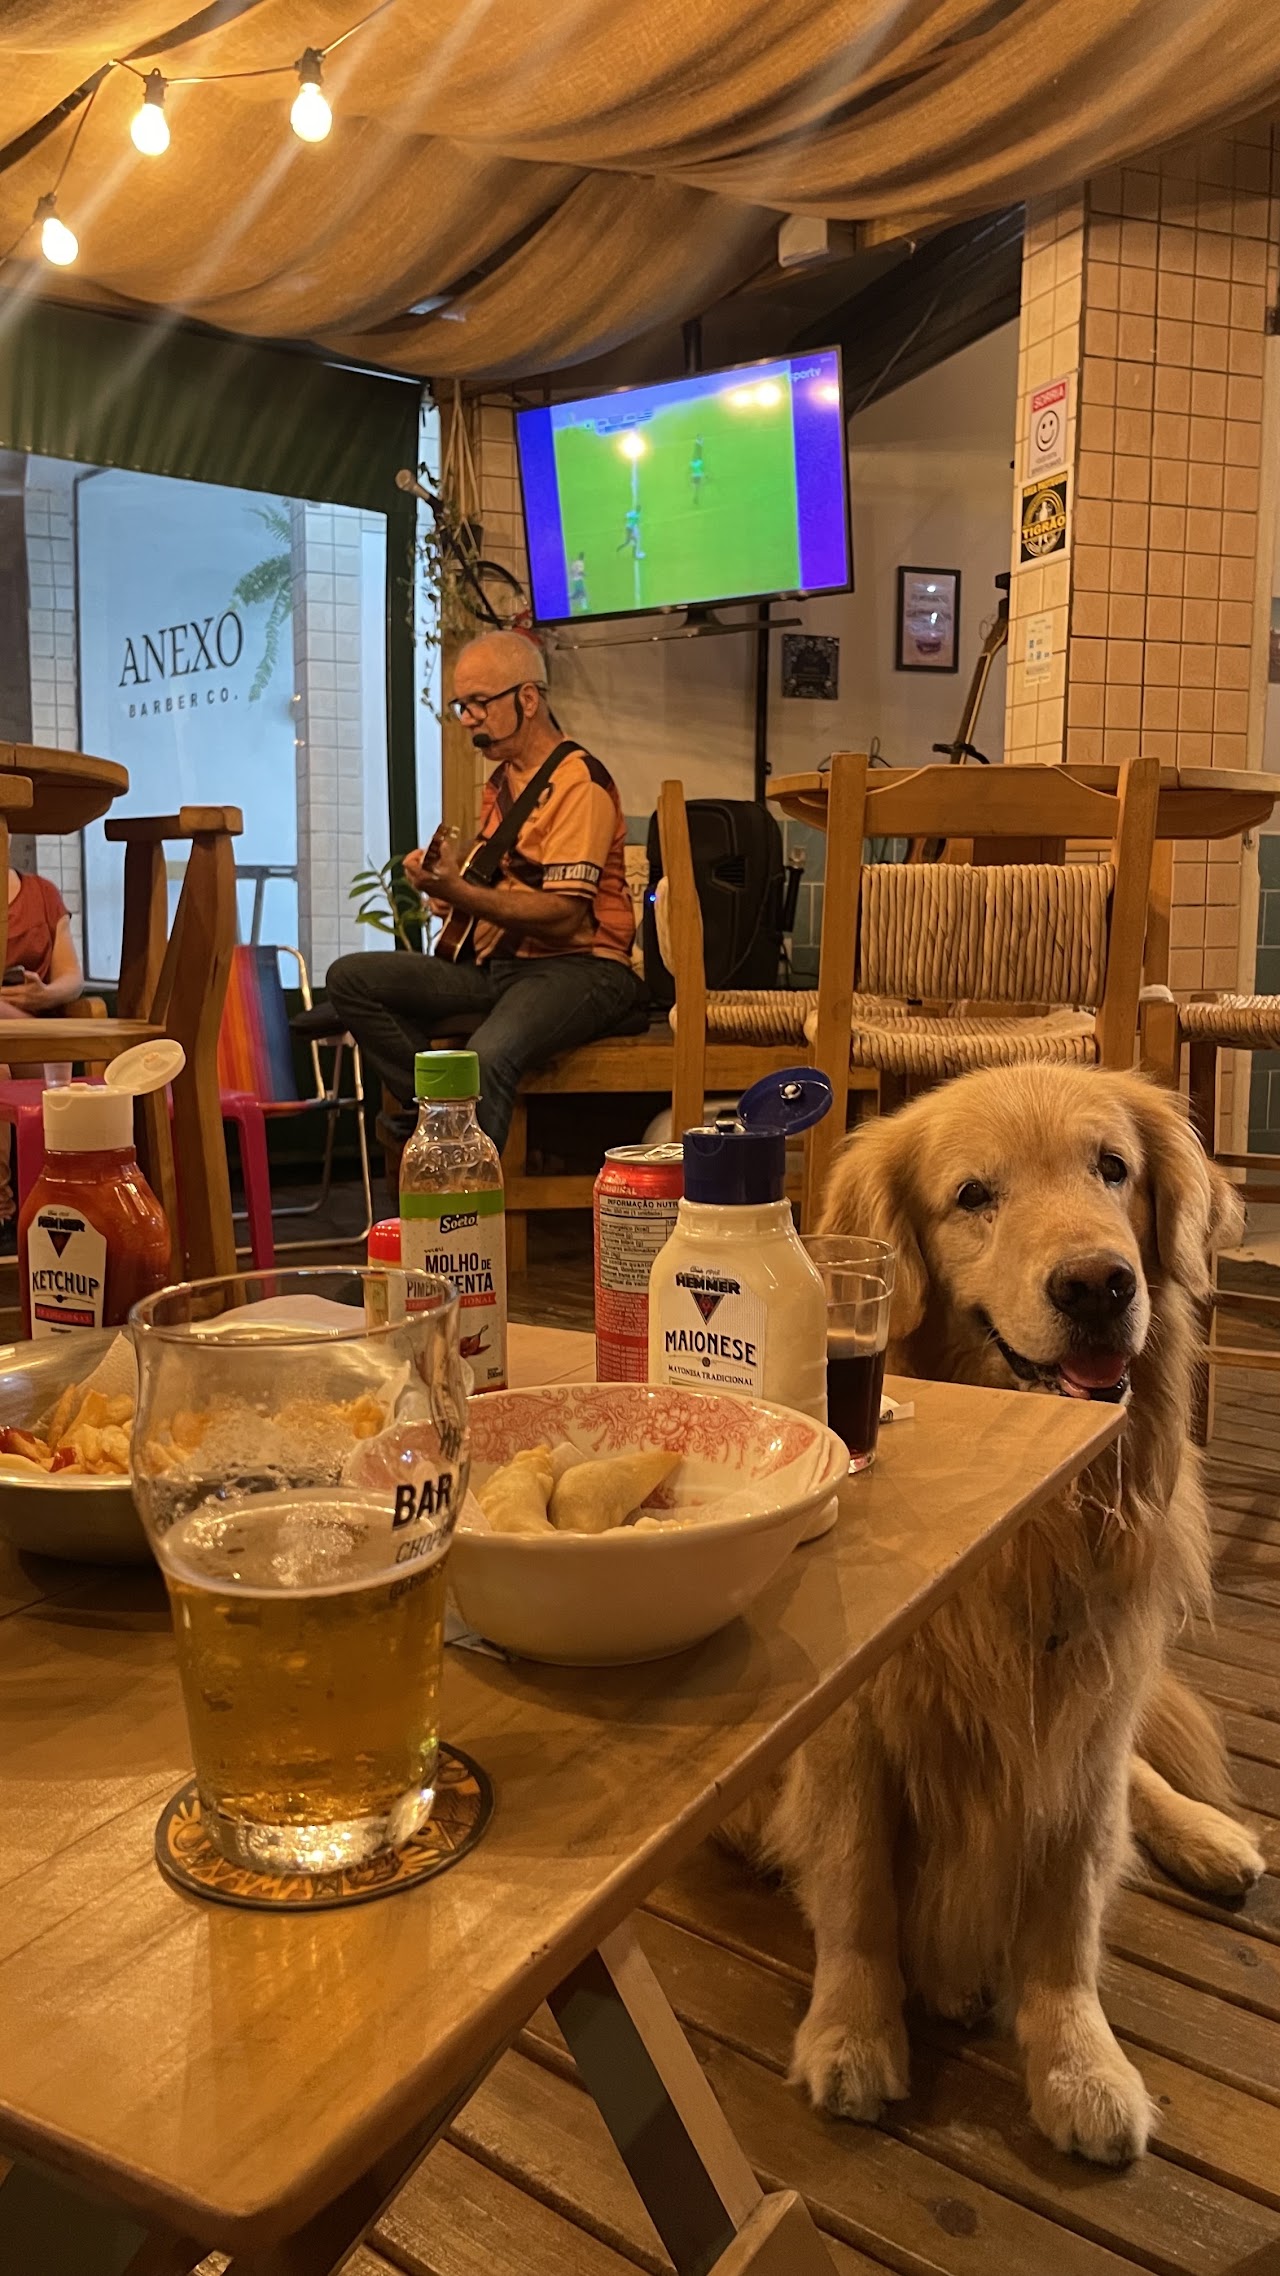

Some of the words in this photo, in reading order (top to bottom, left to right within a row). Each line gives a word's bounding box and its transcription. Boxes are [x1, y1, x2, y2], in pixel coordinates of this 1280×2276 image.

[118, 611, 243, 687] ANEXO
[129, 692, 198, 718] BARBER
[207, 687, 238, 705] CO.
[607, 1198, 654, 1209] INFORMAÇÃO
[425, 1253, 479, 1273] MOLHO
[481, 1258, 491, 1271] DE
[32, 1270, 99, 1298] KETCHUP
[665, 1330, 757, 1367] MAIONESE
[668, 1364, 700, 1379] MAYONESA
[702, 1371, 753, 1386] TRADICIONAL
[392, 1472, 453, 1531] BAR
